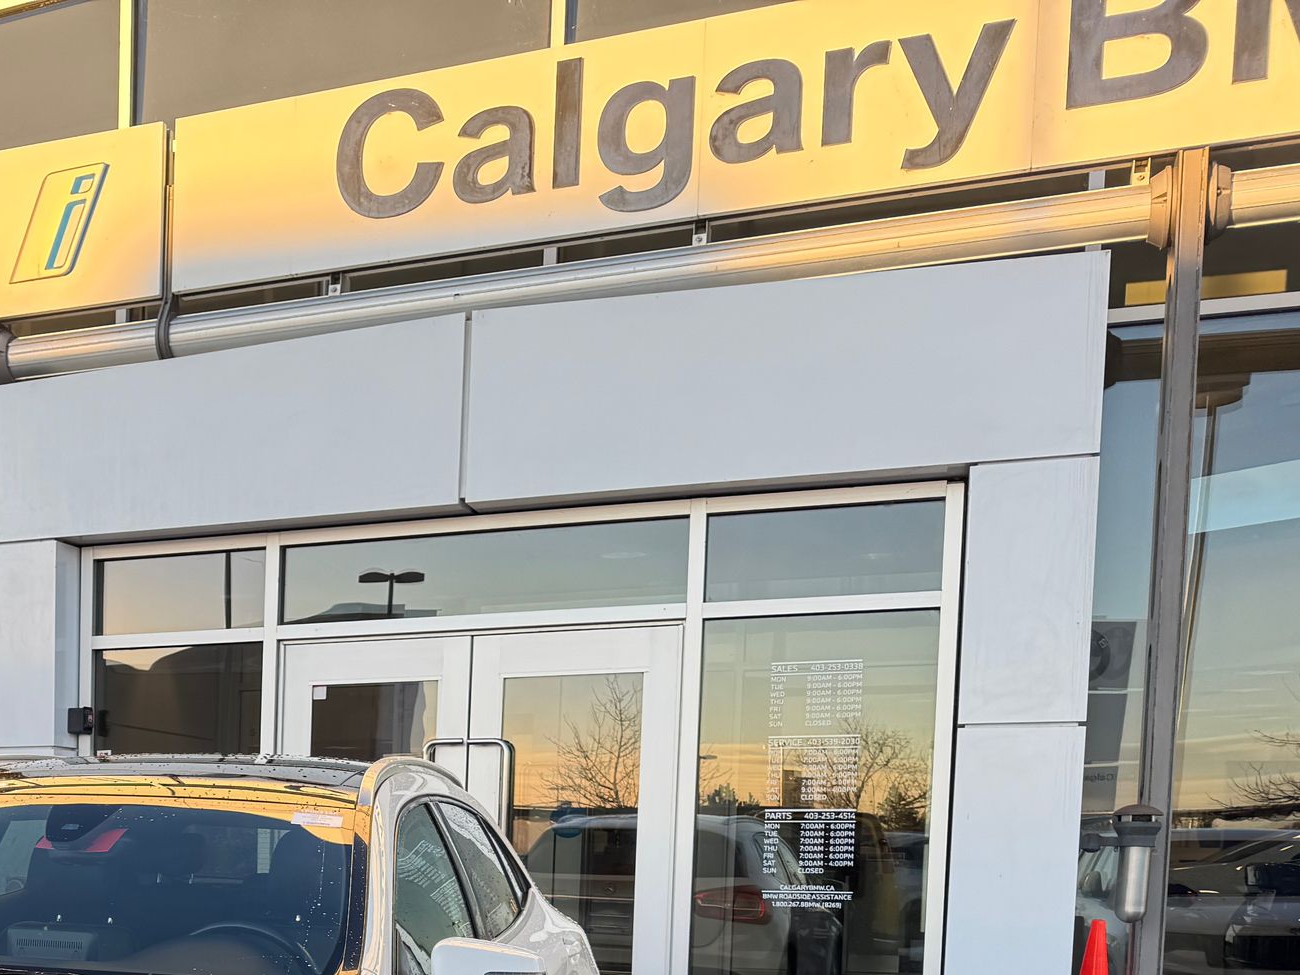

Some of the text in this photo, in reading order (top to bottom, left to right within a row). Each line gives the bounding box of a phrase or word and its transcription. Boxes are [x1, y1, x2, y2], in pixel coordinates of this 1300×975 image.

[336, 0, 1300, 220] Calgary B
[771, 663, 863, 673] SALES 403-253-0338
